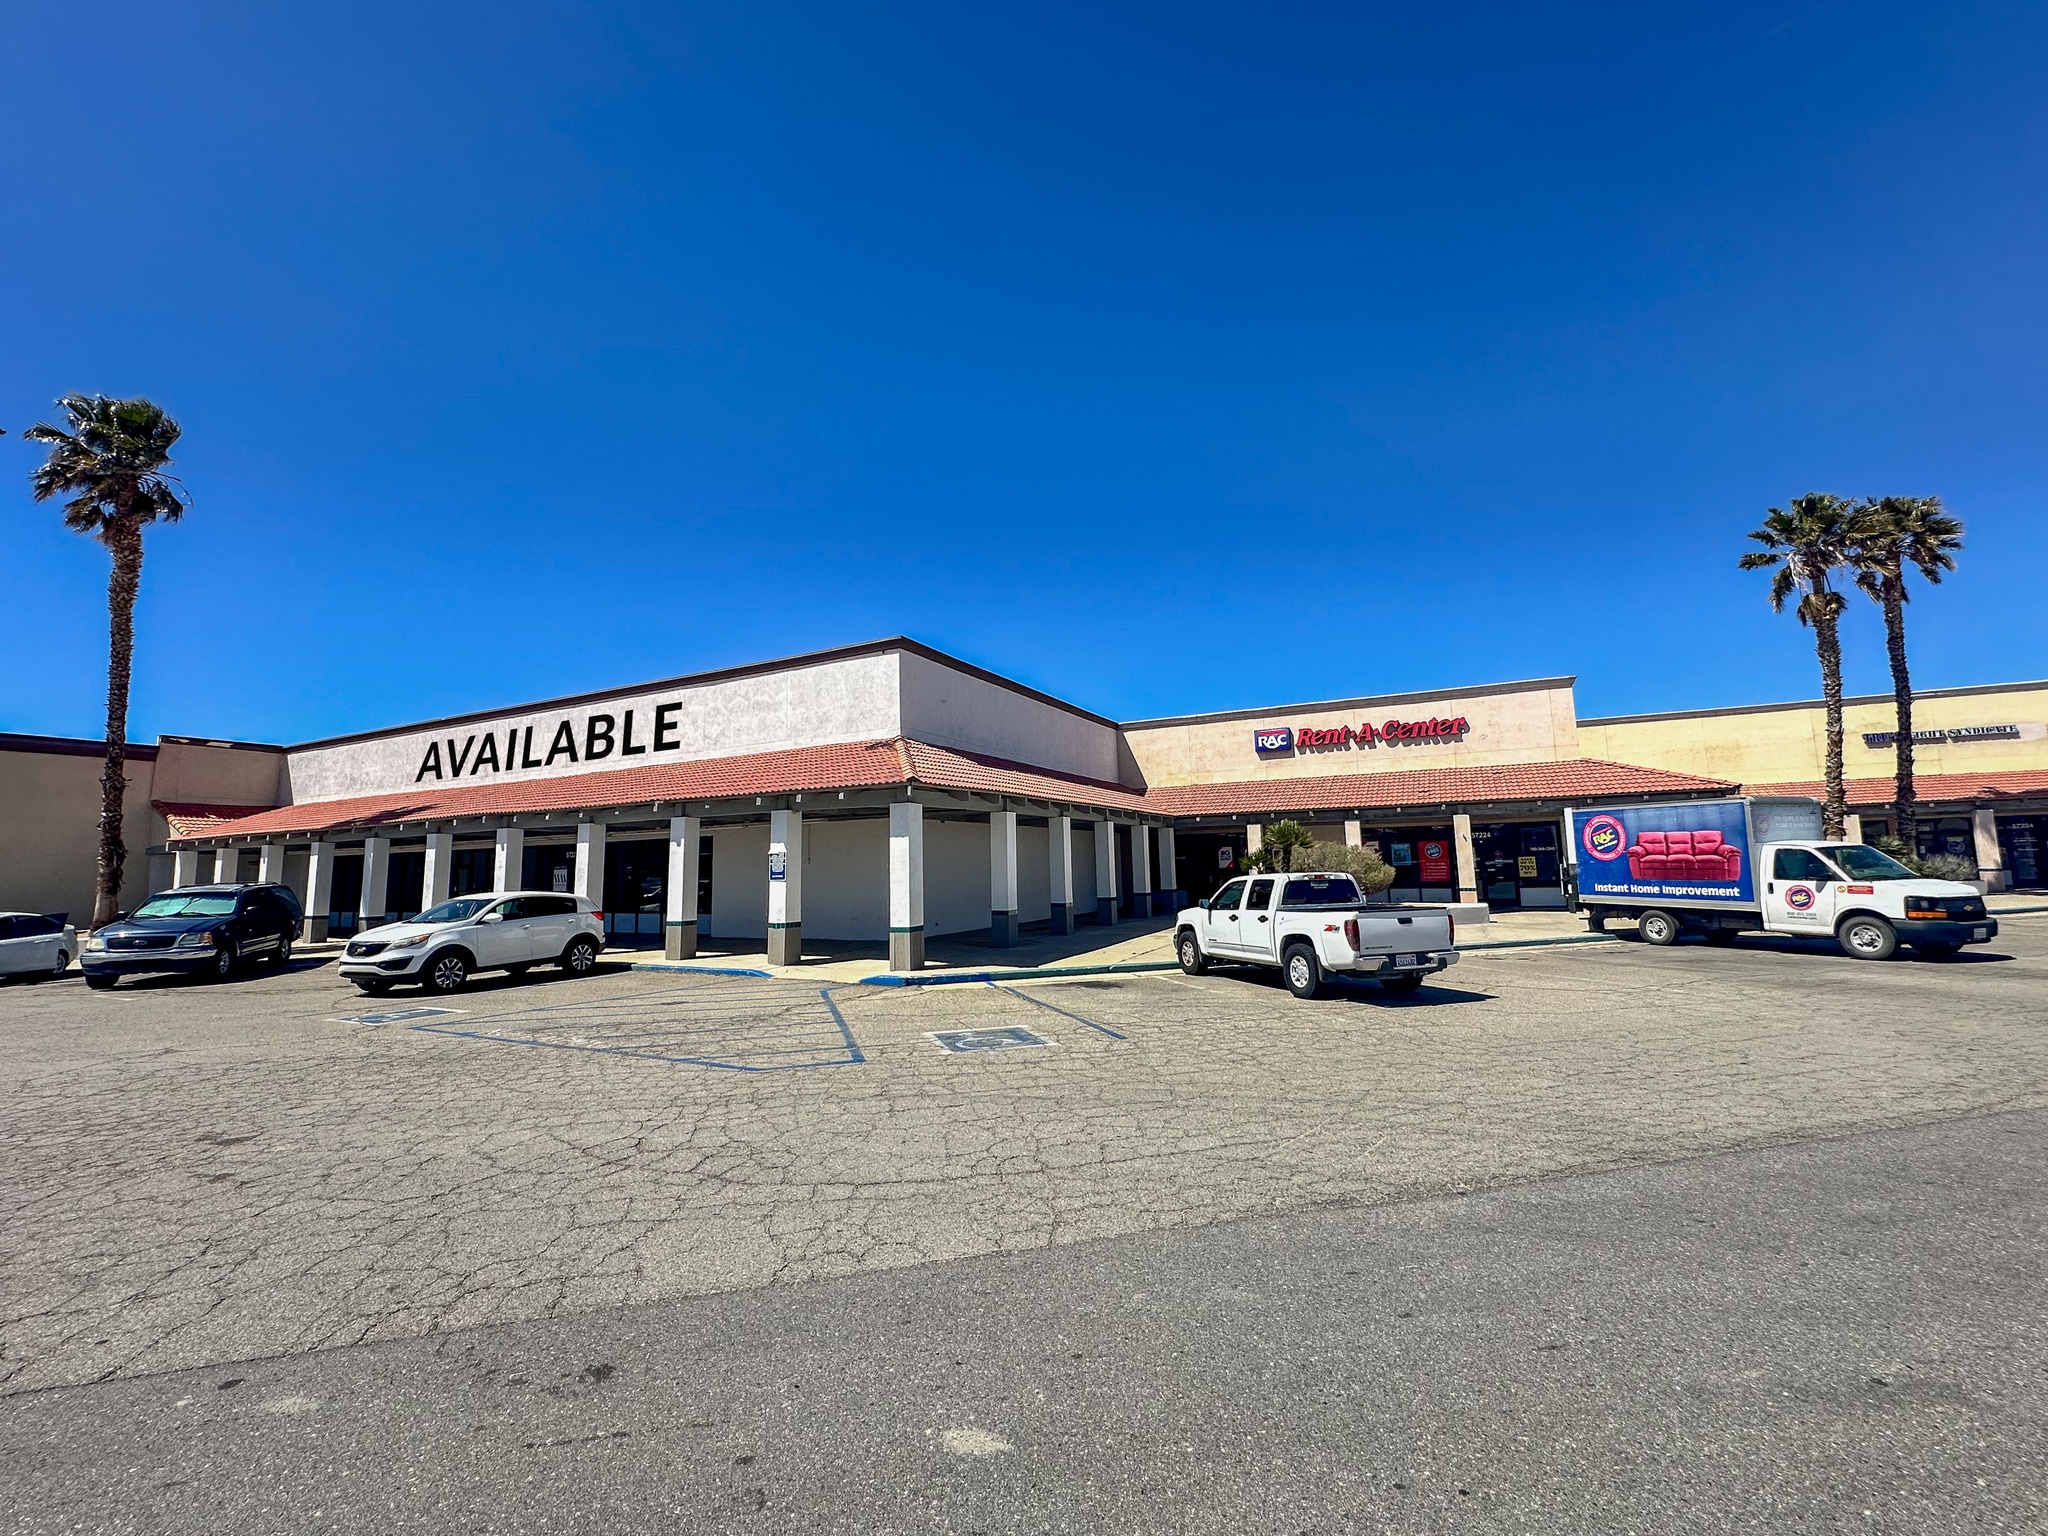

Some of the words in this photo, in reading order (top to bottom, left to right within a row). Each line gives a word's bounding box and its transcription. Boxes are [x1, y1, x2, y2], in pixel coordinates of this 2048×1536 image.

[1906, 730, 1945, 740] IGHT
[1948, 725, 2018, 737] SYNDICATE
[414, 701, 683, 783] AVAILABLE
[1257, 734, 1287, 749] RAC
[1592, 829, 1616, 845] RAC
[1594, 883, 1629, 893] Instant
[1630, 884, 1660, 894] Home
[1662, 885, 1740, 897] Improvement
